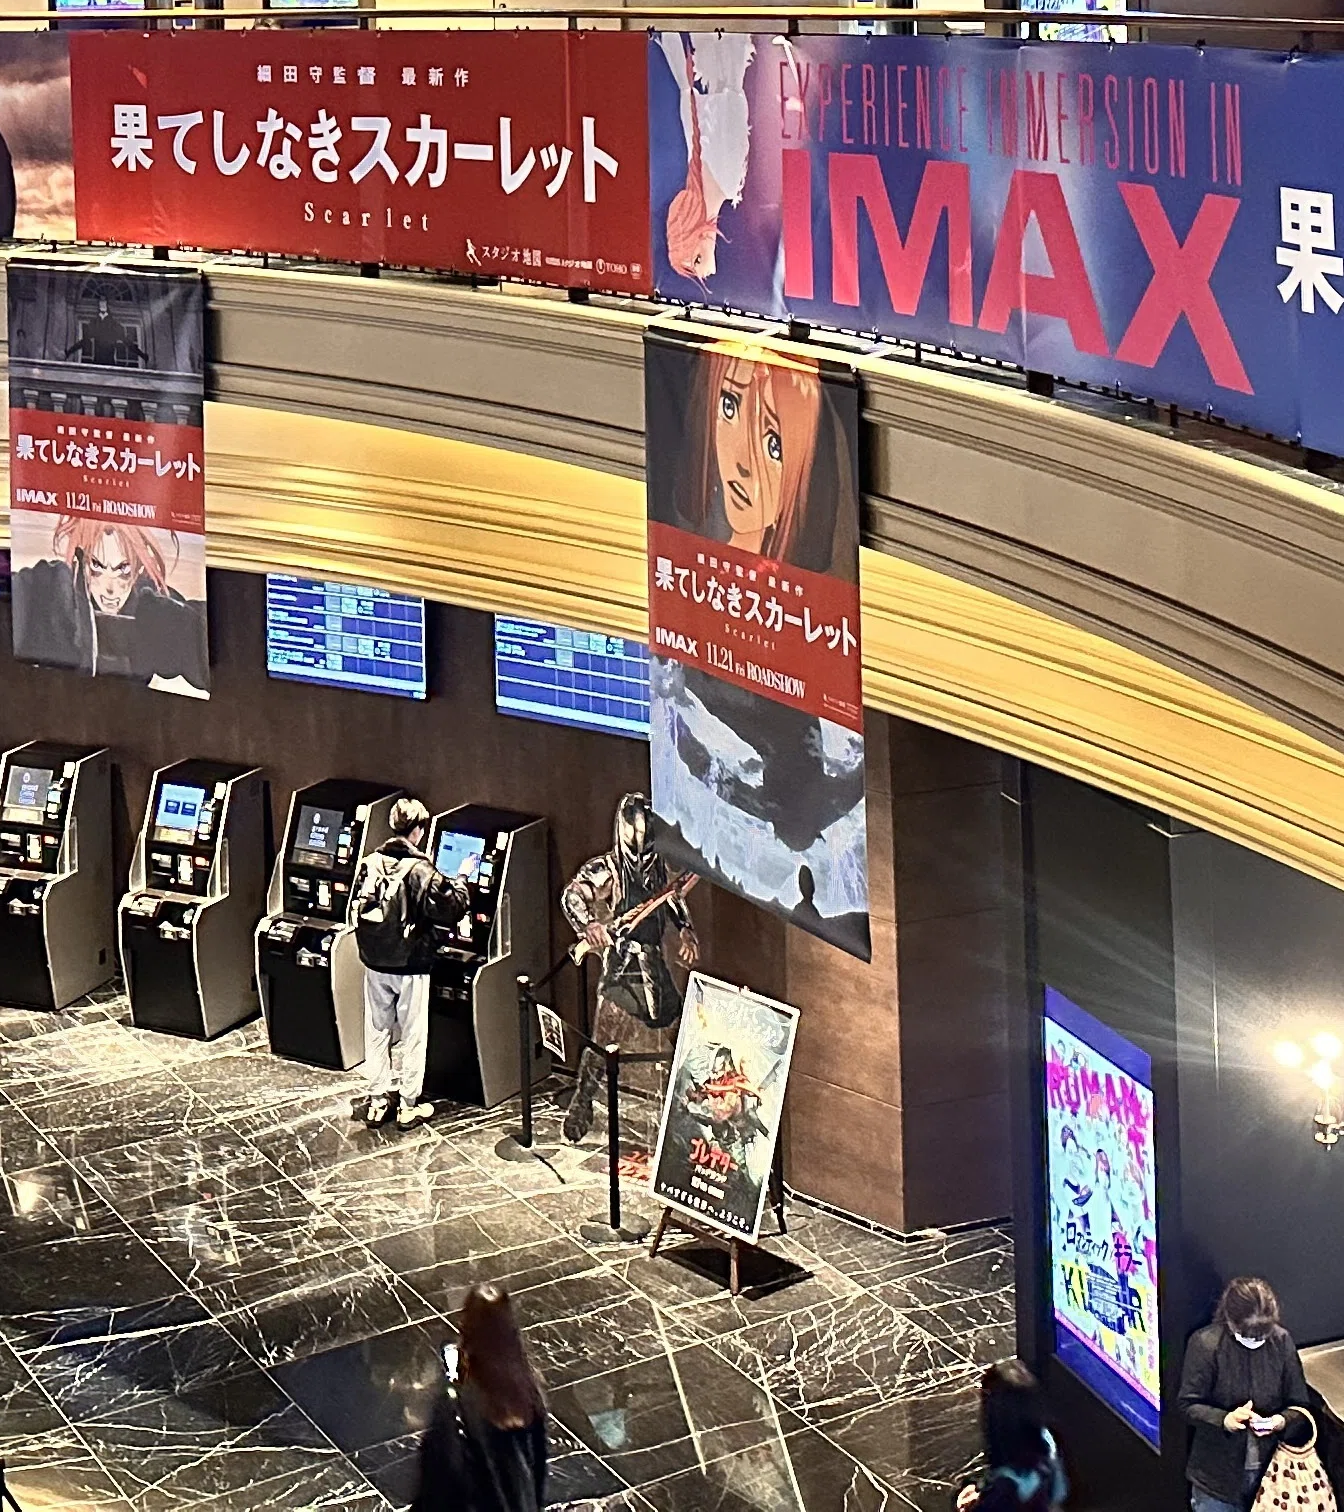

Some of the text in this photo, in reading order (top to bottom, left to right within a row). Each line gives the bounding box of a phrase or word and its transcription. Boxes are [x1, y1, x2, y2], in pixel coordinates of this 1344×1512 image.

[257, 65, 470, 87] 細田守監督 最新作
[779, 61, 1242, 186] EXPERIENCE IMMERSION IN
[110, 103, 618, 204] 果てしなきスカーレット
[304, 200, 431, 233] Scarlet
[482, 245, 542, 268] スタジオ地図
[606, 263, 628, 275] TOHO
[782, 148, 1255, 396] IMAX
[16, 434, 201, 482] 果てしなきスカーレット
[16, 488, 58, 507] IMAX
[66, 491, 91, 513] 11.21
[103, 499, 157, 520] ROADSHOW
[656, 556, 857, 656] 果てしなきスカーレット
[656, 626, 699, 658] IMAX
[706, 641, 734, 673] 11.21
[746, 660, 806, 699] ROADSHOW
